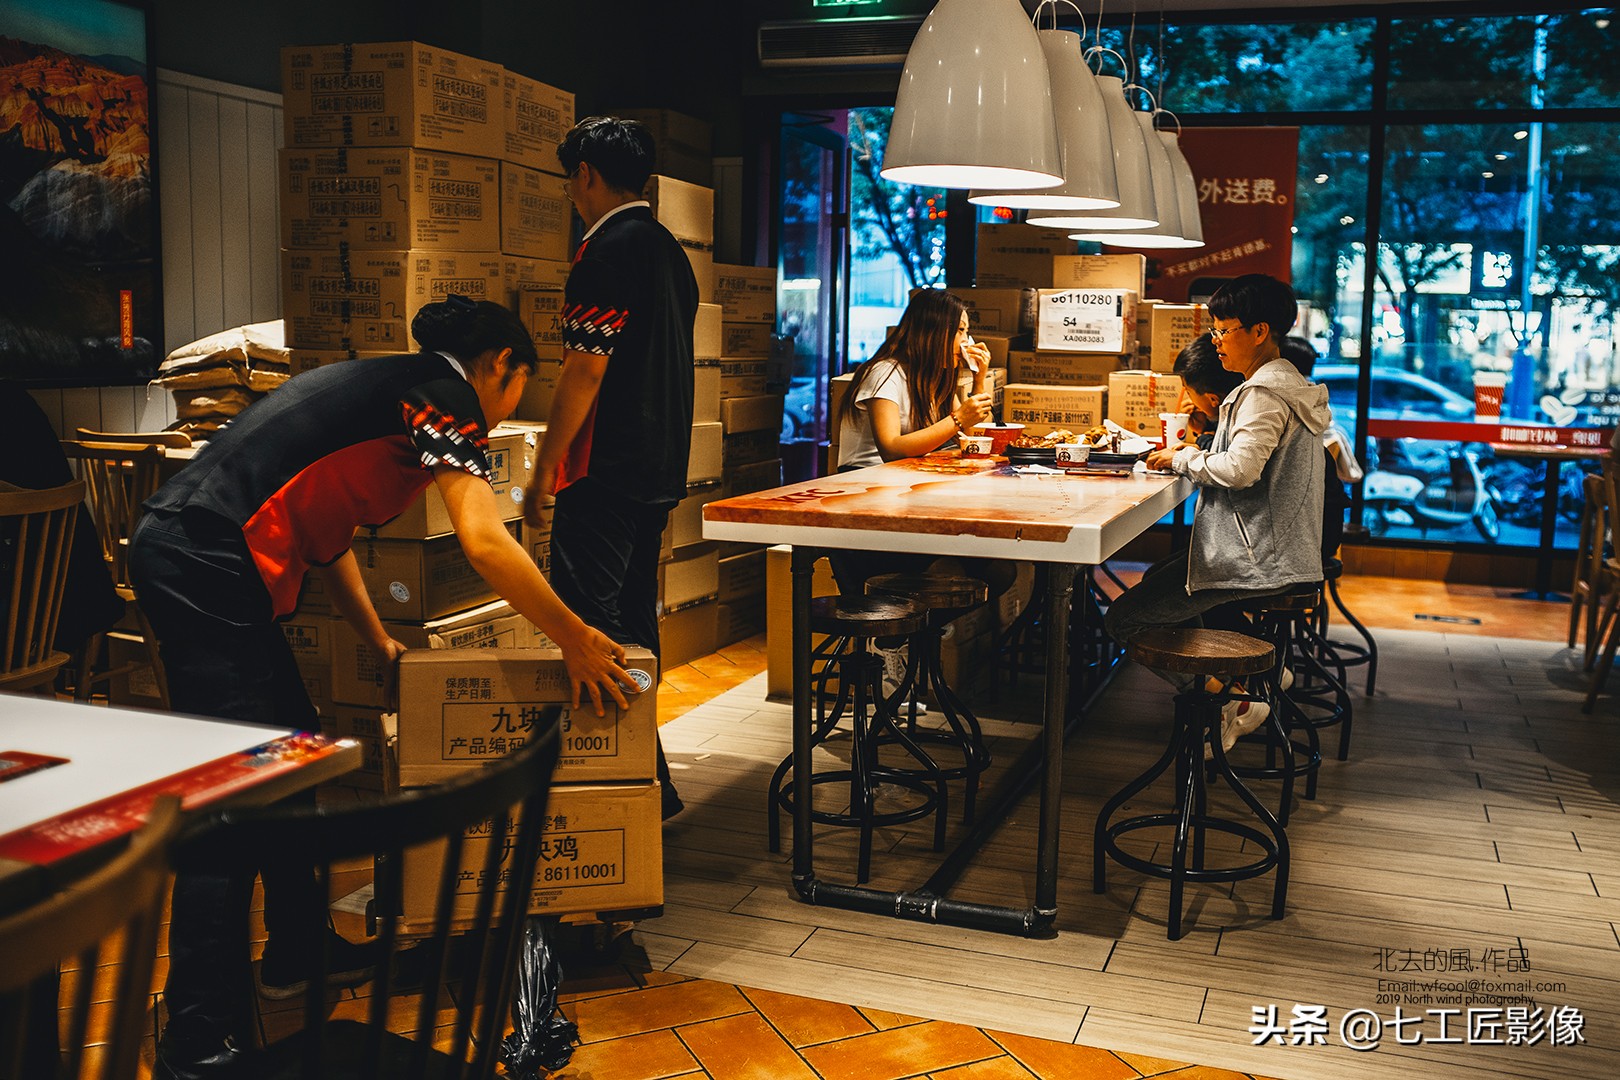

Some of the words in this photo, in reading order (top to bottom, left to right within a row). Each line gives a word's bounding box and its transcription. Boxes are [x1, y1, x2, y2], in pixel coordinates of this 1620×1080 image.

[1063, 317, 1078, 327] 54
[446, 677, 496, 689] 保质期至:
[446, 689, 496, 700] 生产日期:
[490, 706, 573, 734] 九块
[449, 735, 611, 756] 产品编码10001
[456, 863, 617, 889] 产品编:86110001
